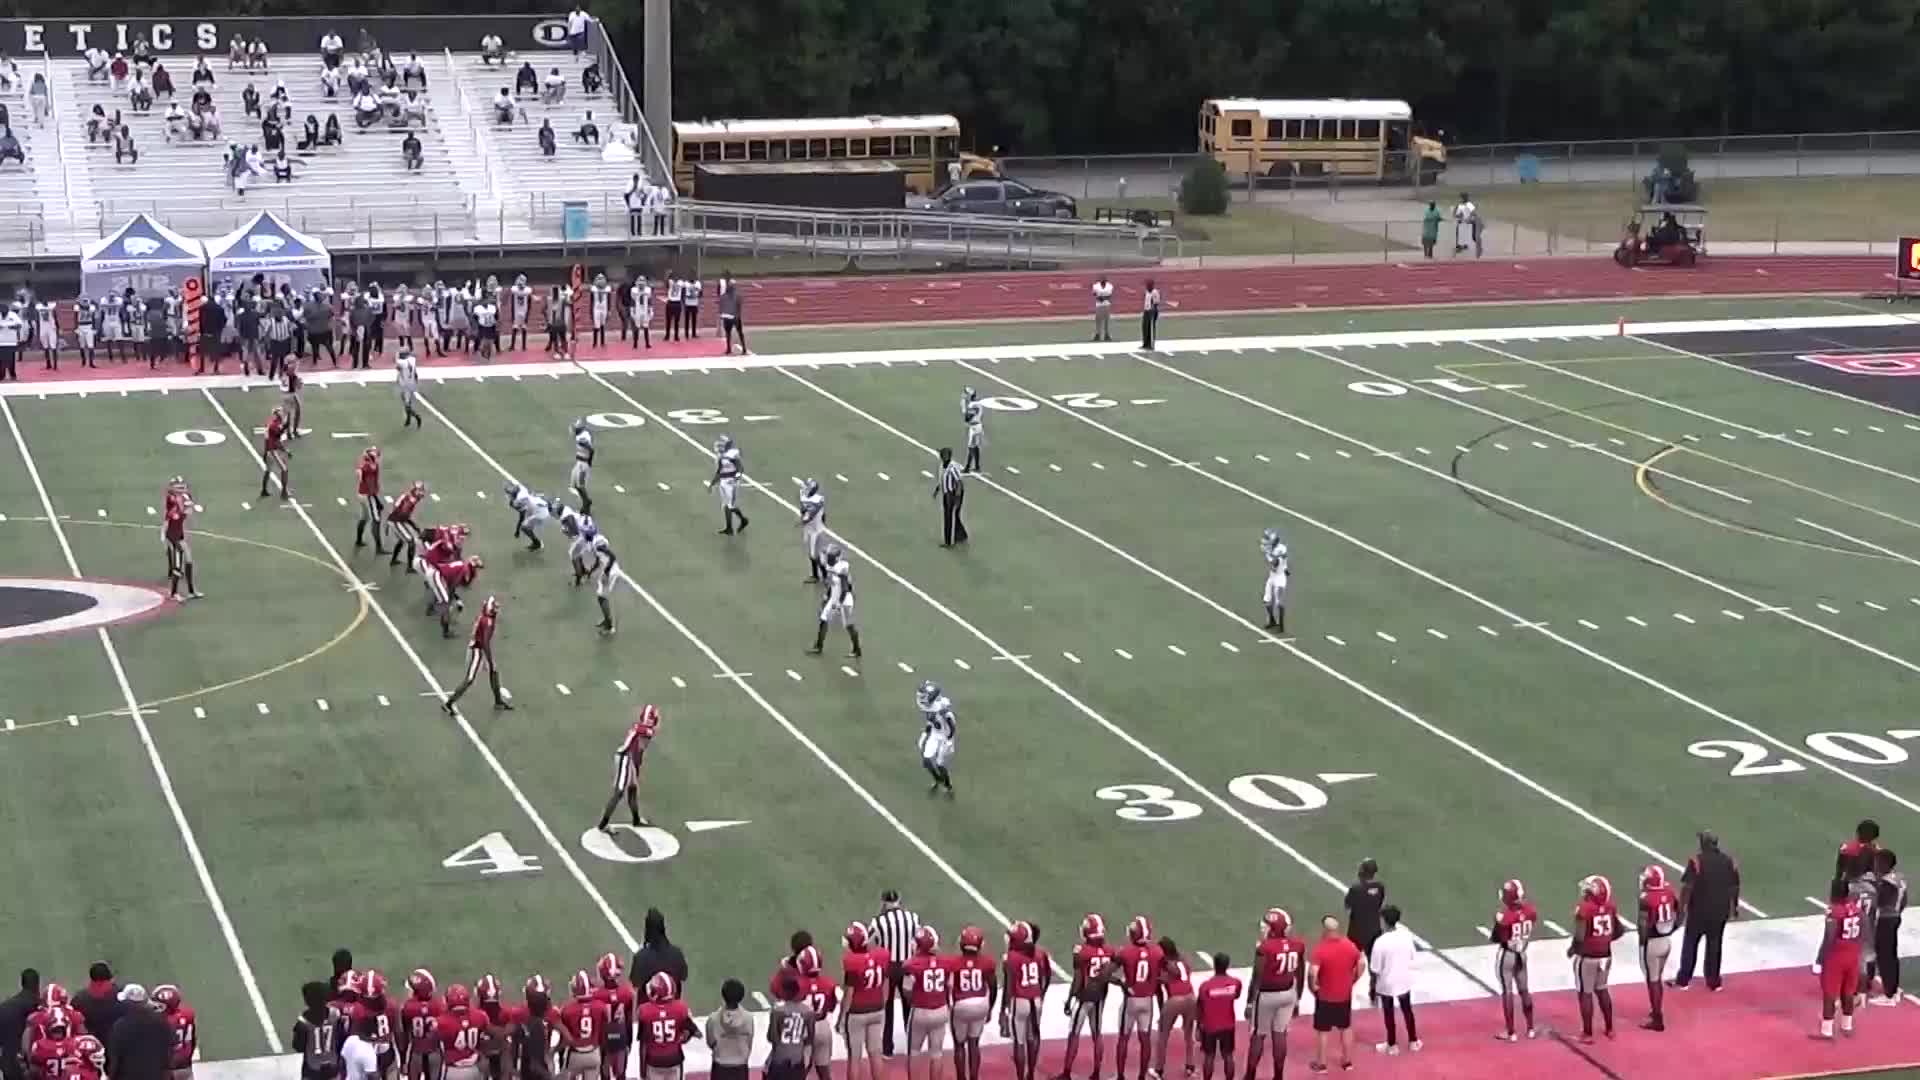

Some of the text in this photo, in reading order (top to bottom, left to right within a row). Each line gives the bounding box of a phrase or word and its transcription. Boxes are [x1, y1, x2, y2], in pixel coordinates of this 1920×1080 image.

[1687, 731, 1909, 777] 20
[1094, 773, 1330, 821] 30
[442, 822, 682, 876] 40
[1021, 962, 1039, 986] 19
[1136, 960, 1149, 982] 0
[1275, 951, 1298, 975] 70
[923, 968, 946, 992] 62
[960, 970, 982, 993] 60
[313, 1024, 334, 1055] 17
[453, 1027, 479, 1051] 40
[580, 1016, 592, 1039] 9
[652, 1018, 676, 1044] 95
